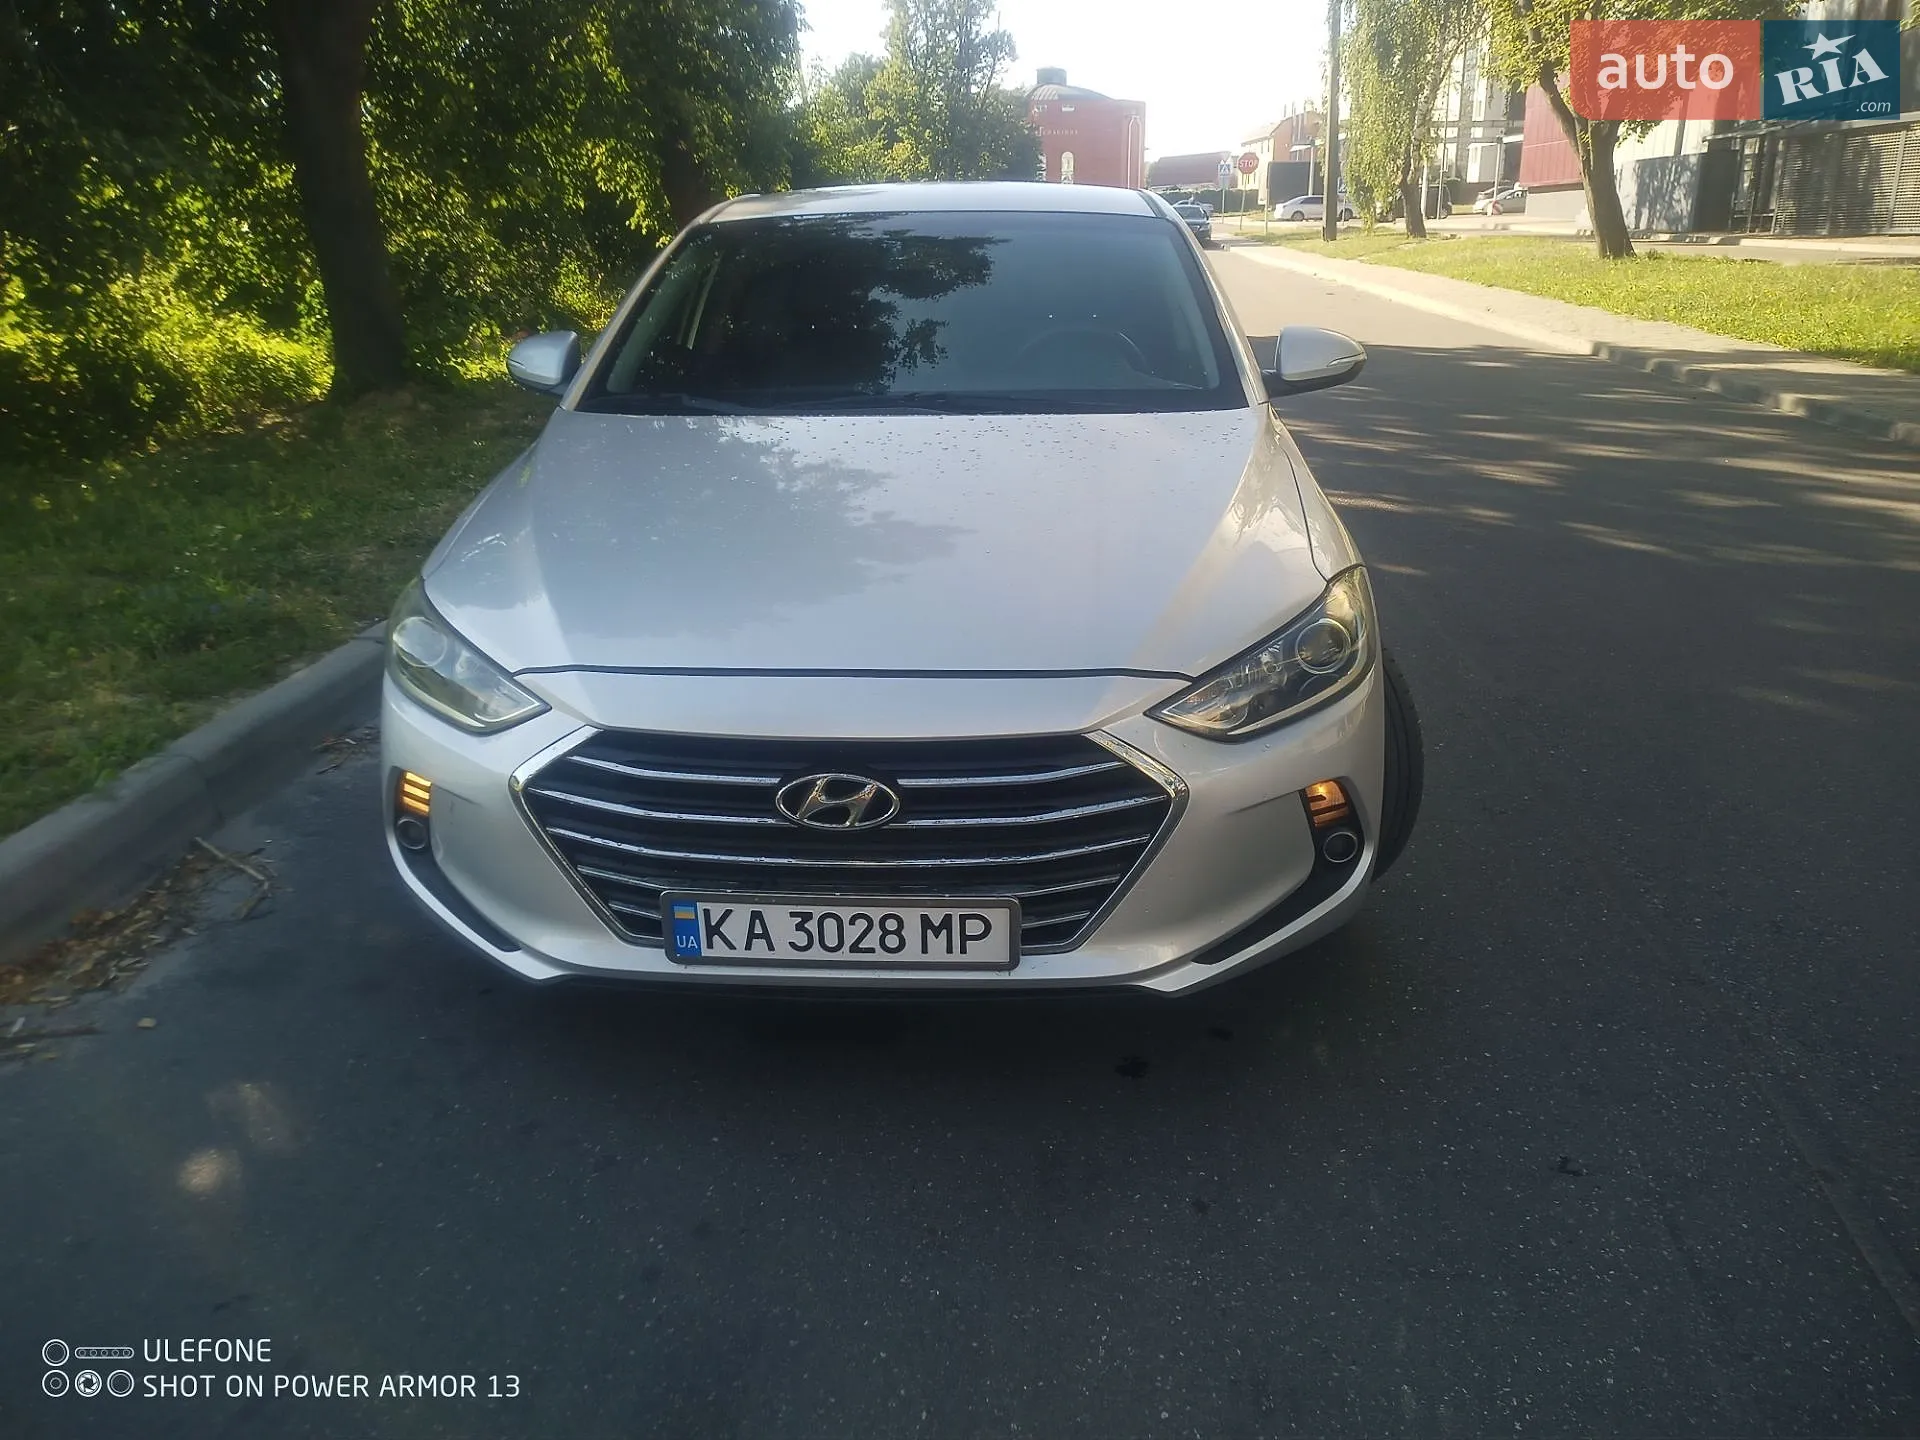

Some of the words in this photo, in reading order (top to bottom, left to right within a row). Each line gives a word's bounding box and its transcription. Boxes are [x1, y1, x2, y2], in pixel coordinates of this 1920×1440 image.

[676, 935, 698, 949] UA
[703, 908, 776, 951] KA
[788, 910, 906, 954] 3028
[920, 912, 993, 955] MP
